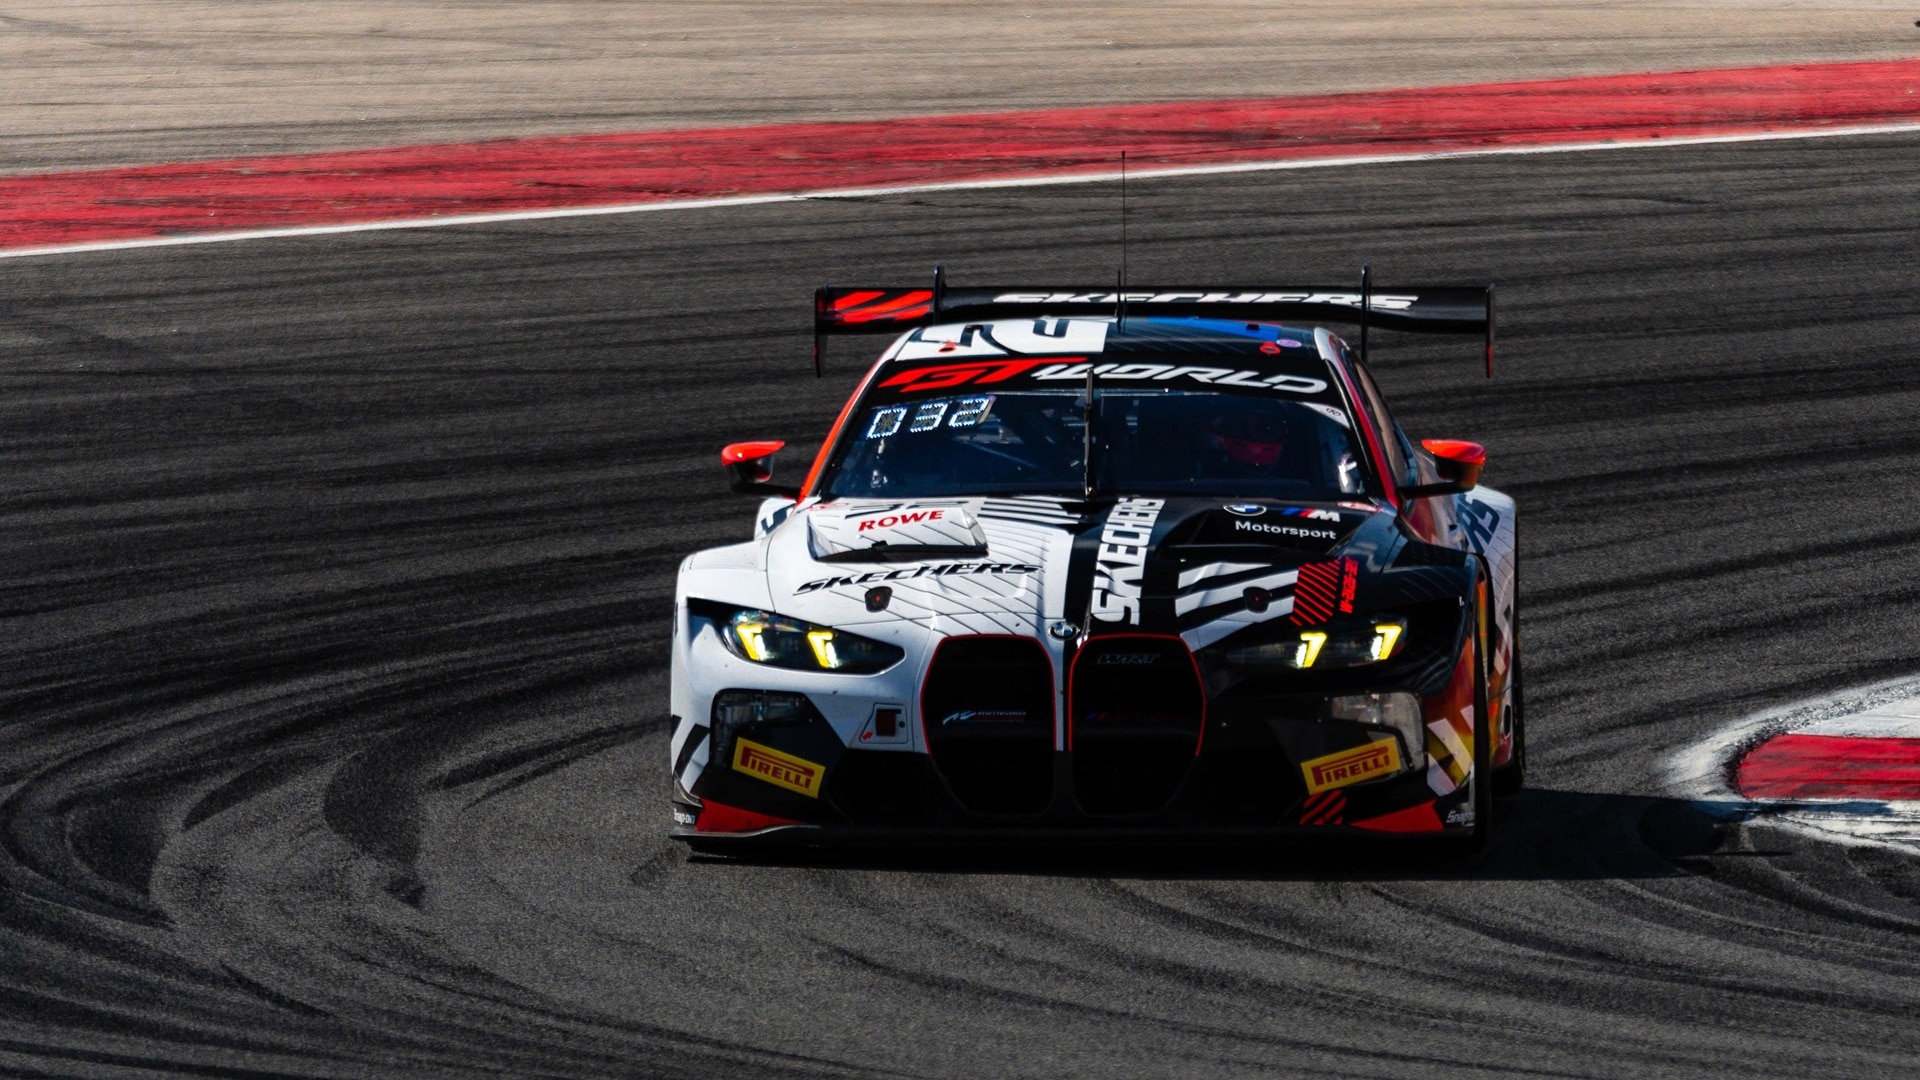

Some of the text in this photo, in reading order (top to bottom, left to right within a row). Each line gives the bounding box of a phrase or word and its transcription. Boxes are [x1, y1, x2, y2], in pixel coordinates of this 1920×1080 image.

[993, 291, 1419, 310] SKECHERS
[877, 356, 1328, 394] GT WORLD
[866, 397, 991, 439] 032
[858, 509, 945, 533] ROWE
[1234, 520, 1338, 540] Motorsport
[793, 561, 1044, 596] SKECHERS
[1091, 497, 1166, 626] SKECHERS
[740, 746, 815, 790] PIRELLI
[1311, 745, 1391, 786] PIRELLI
